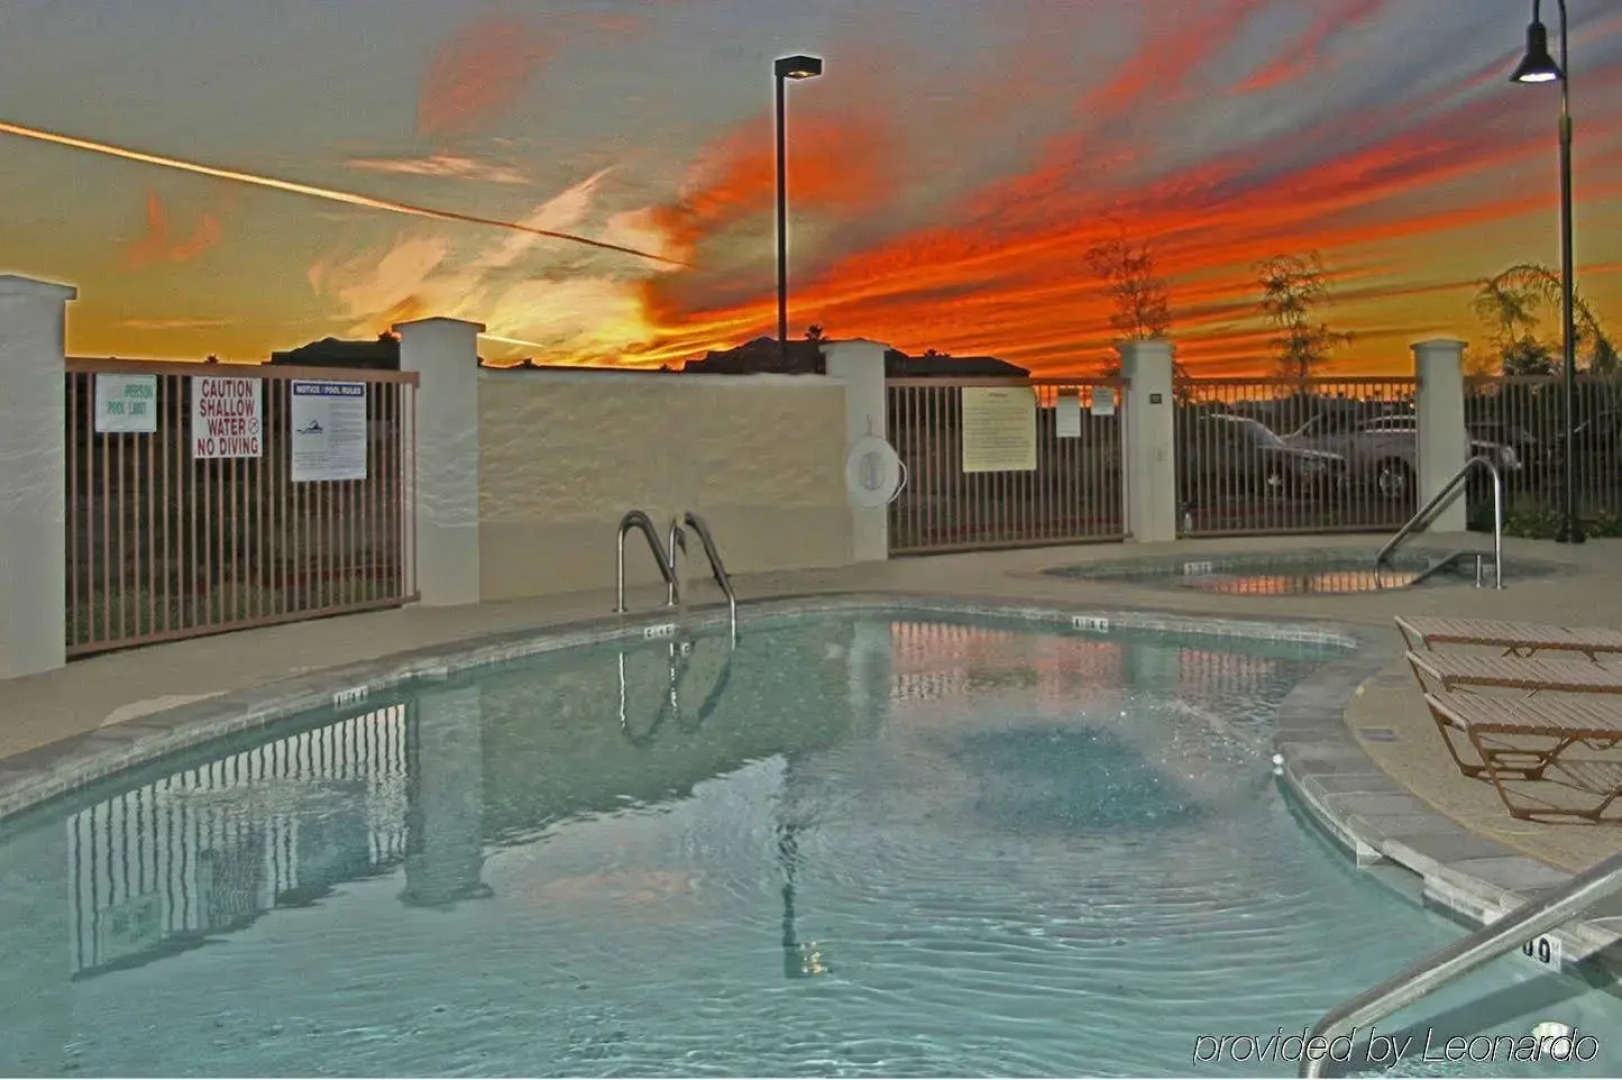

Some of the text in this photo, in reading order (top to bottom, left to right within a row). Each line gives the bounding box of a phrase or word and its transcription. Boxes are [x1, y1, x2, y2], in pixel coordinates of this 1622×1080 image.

[201, 379, 253, 398] CAUTION
[200, 399, 255, 417] SHALLOW
[208, 418, 246, 436] WATER
[197, 437, 259, 456] NO DIVING
